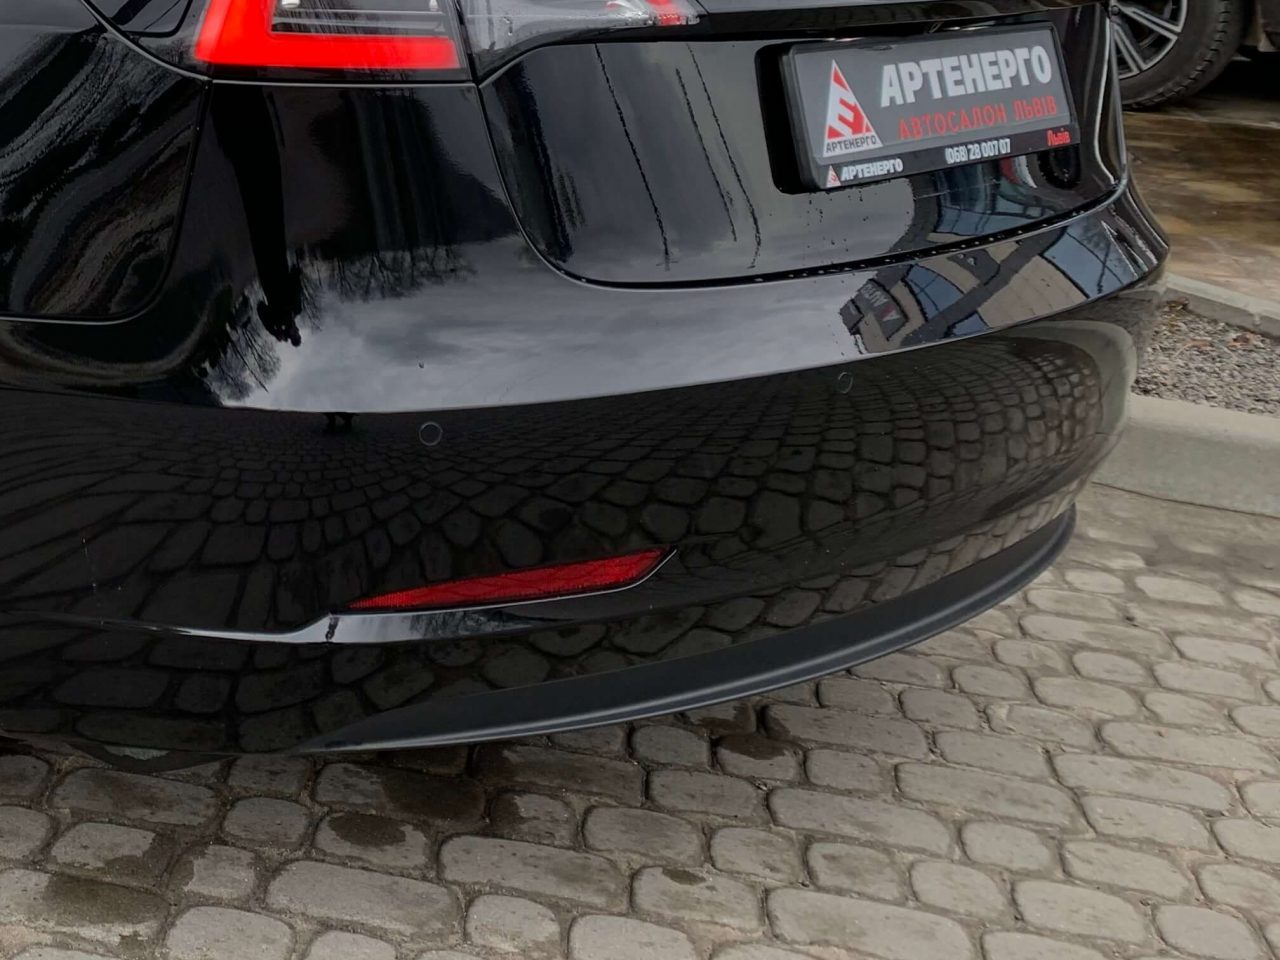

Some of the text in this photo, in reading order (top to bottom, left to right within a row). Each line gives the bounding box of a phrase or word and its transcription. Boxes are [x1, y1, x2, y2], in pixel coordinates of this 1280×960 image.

[880, 45, 1052, 108] АРТЕНЕРГО
[899, 95, 1057, 140] АВТОСАЛОН ЛЬВІВ
[826, 135, 877, 153] АРТЕНЕРГО
[841, 157, 904, 182] АРТЕНЕРГО
[981, 140, 999, 158] 007
[999, 138, 1011, 154] 07
[1047, 128, 1071, 147] Львів
